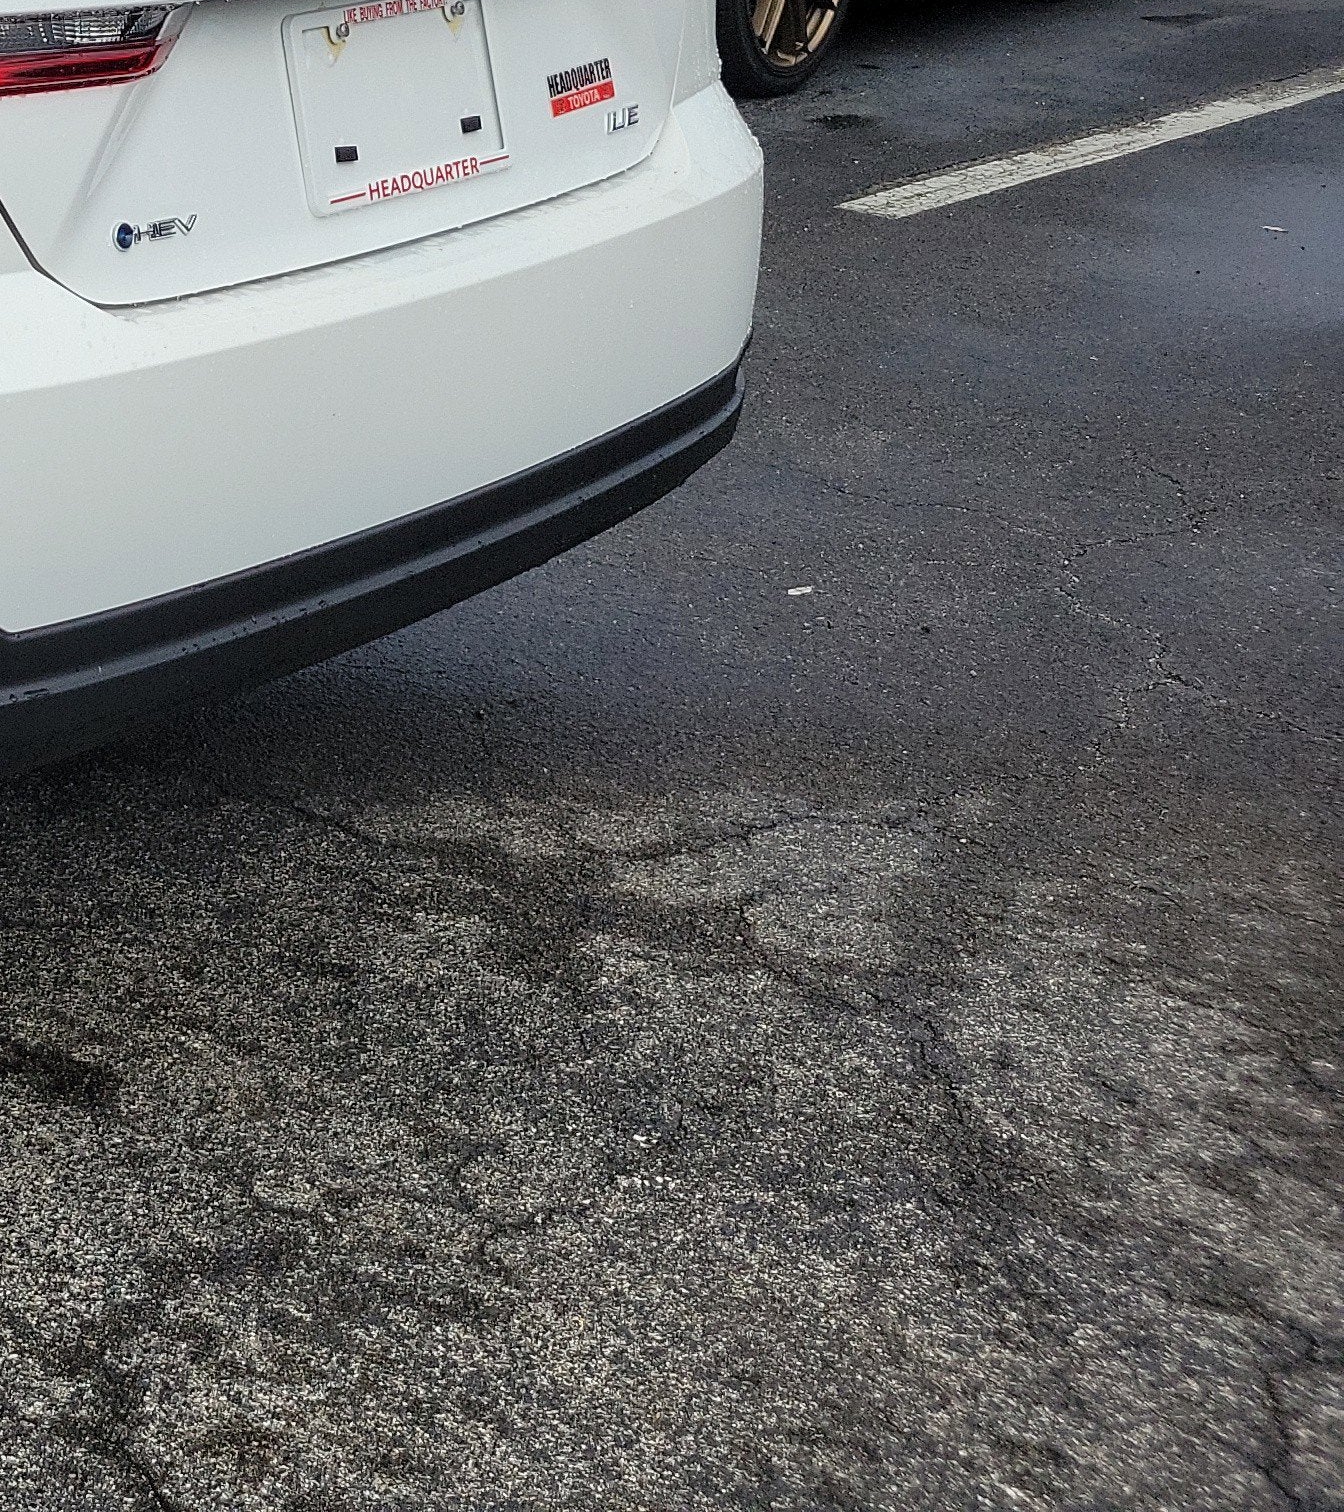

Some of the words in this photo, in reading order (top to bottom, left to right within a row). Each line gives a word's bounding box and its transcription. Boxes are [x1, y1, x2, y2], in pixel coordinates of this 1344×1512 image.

[385, 0, 403, 18] FROM
[547, 57, 612, 99] HEADQUARTER
[568, 88, 601, 110] TOYOTA
[368, 157, 480, 201] HEADQUARTER
